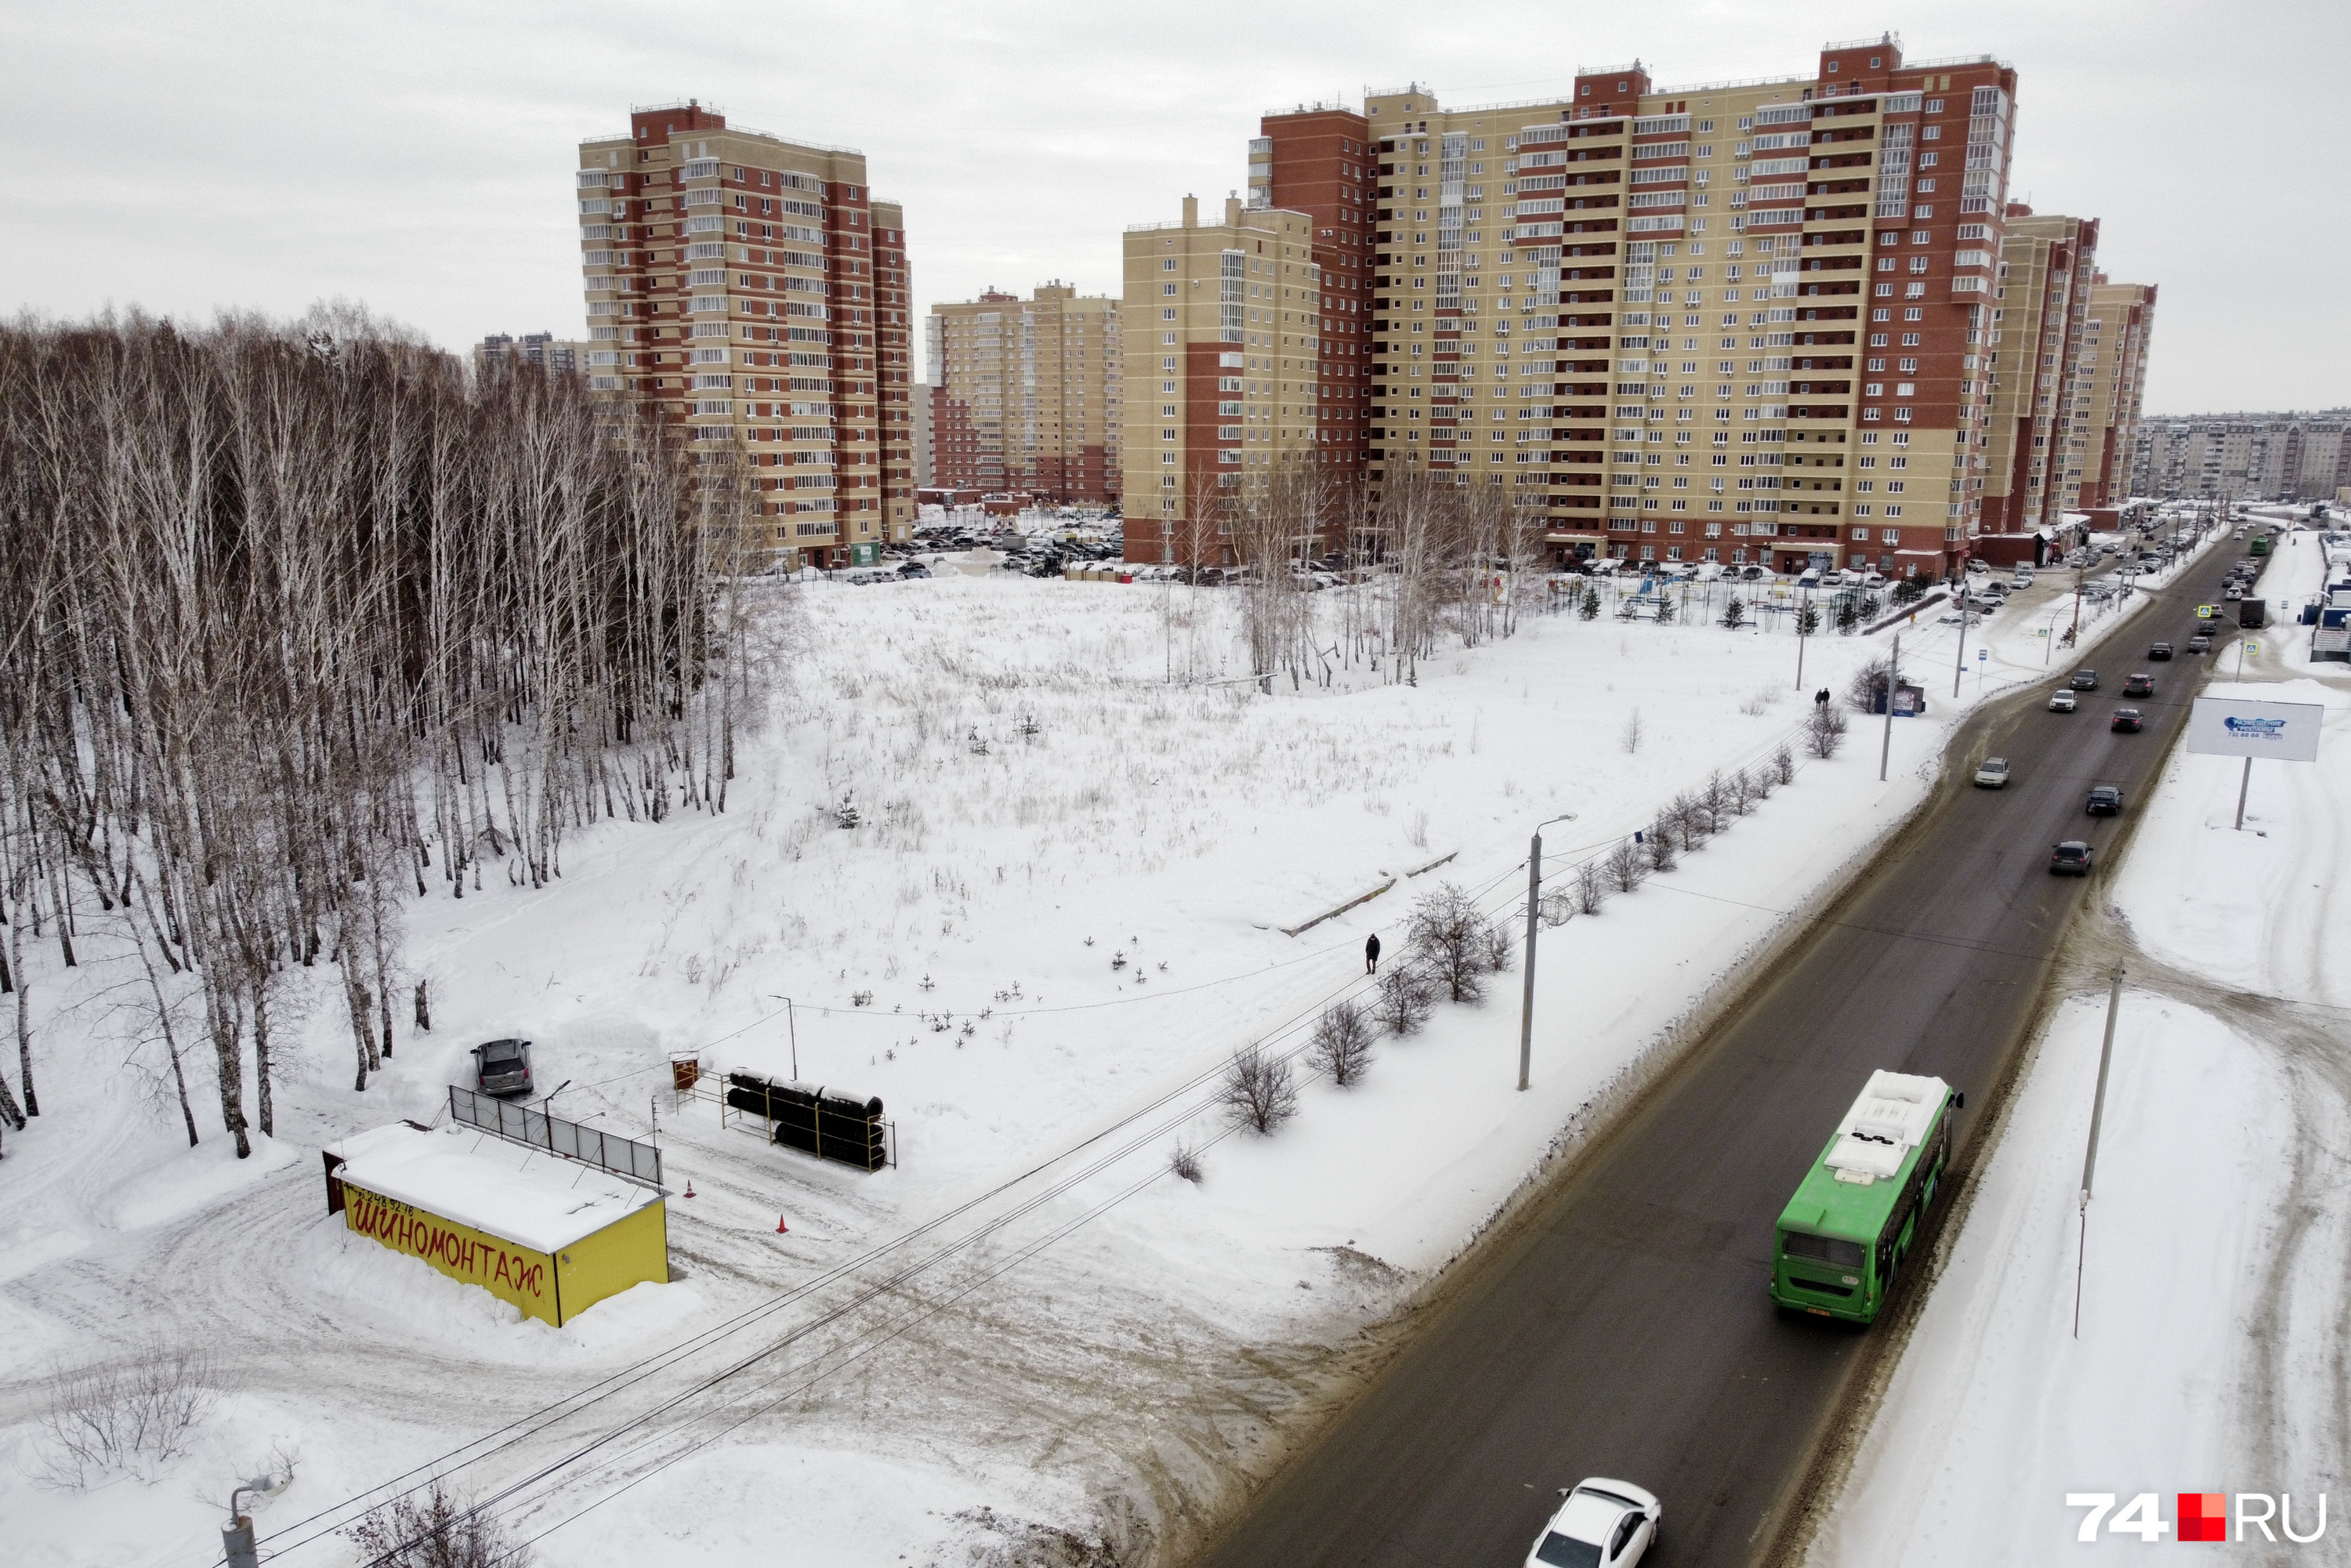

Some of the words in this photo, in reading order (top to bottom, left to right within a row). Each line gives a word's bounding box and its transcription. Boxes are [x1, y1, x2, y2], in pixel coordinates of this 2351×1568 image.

[368, 1190, 387, 1208] 248
[390, 1199, 400, 1212] 92
[353, 1199, 543, 1298] ШИНОМОНТАЖ
